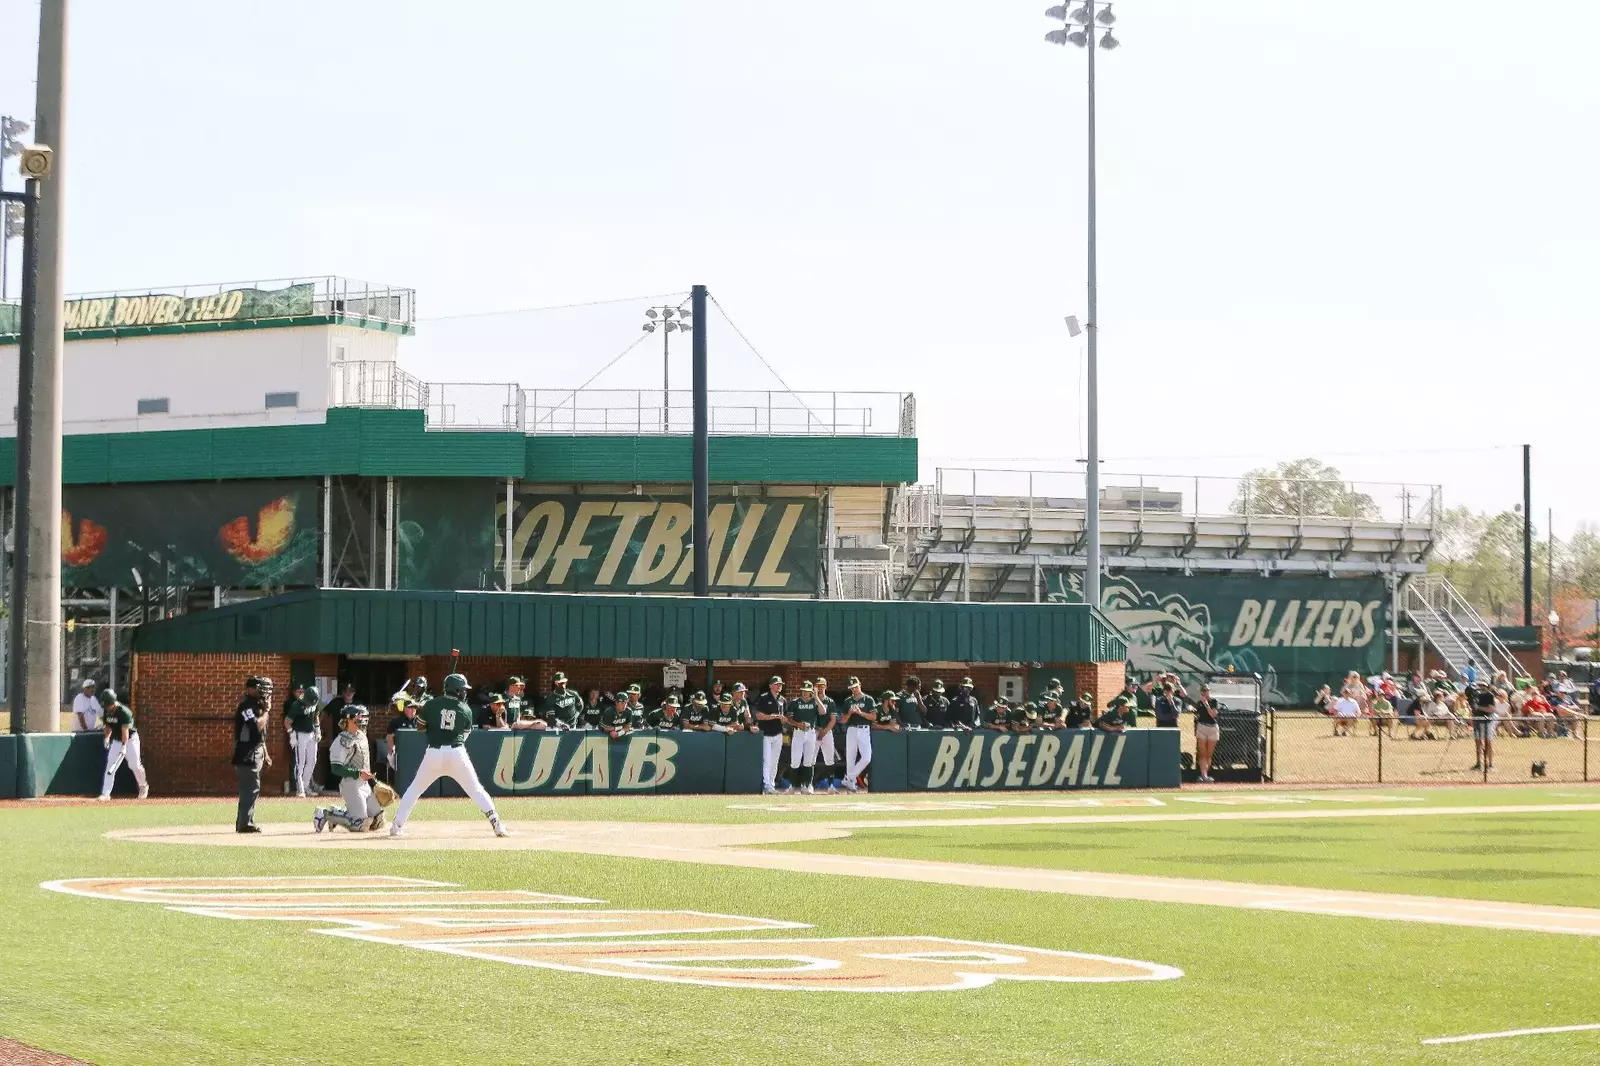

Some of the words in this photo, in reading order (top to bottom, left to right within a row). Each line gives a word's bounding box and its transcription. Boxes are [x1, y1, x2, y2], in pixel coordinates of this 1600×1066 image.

[186, 290, 243, 321] FIELD
[1229, 599, 1381, 648] BLAZERS
[440, 708, 457, 731] 19
[492, 736, 679, 791] UAB
[927, 736, 1126, 789] BASEBALL
